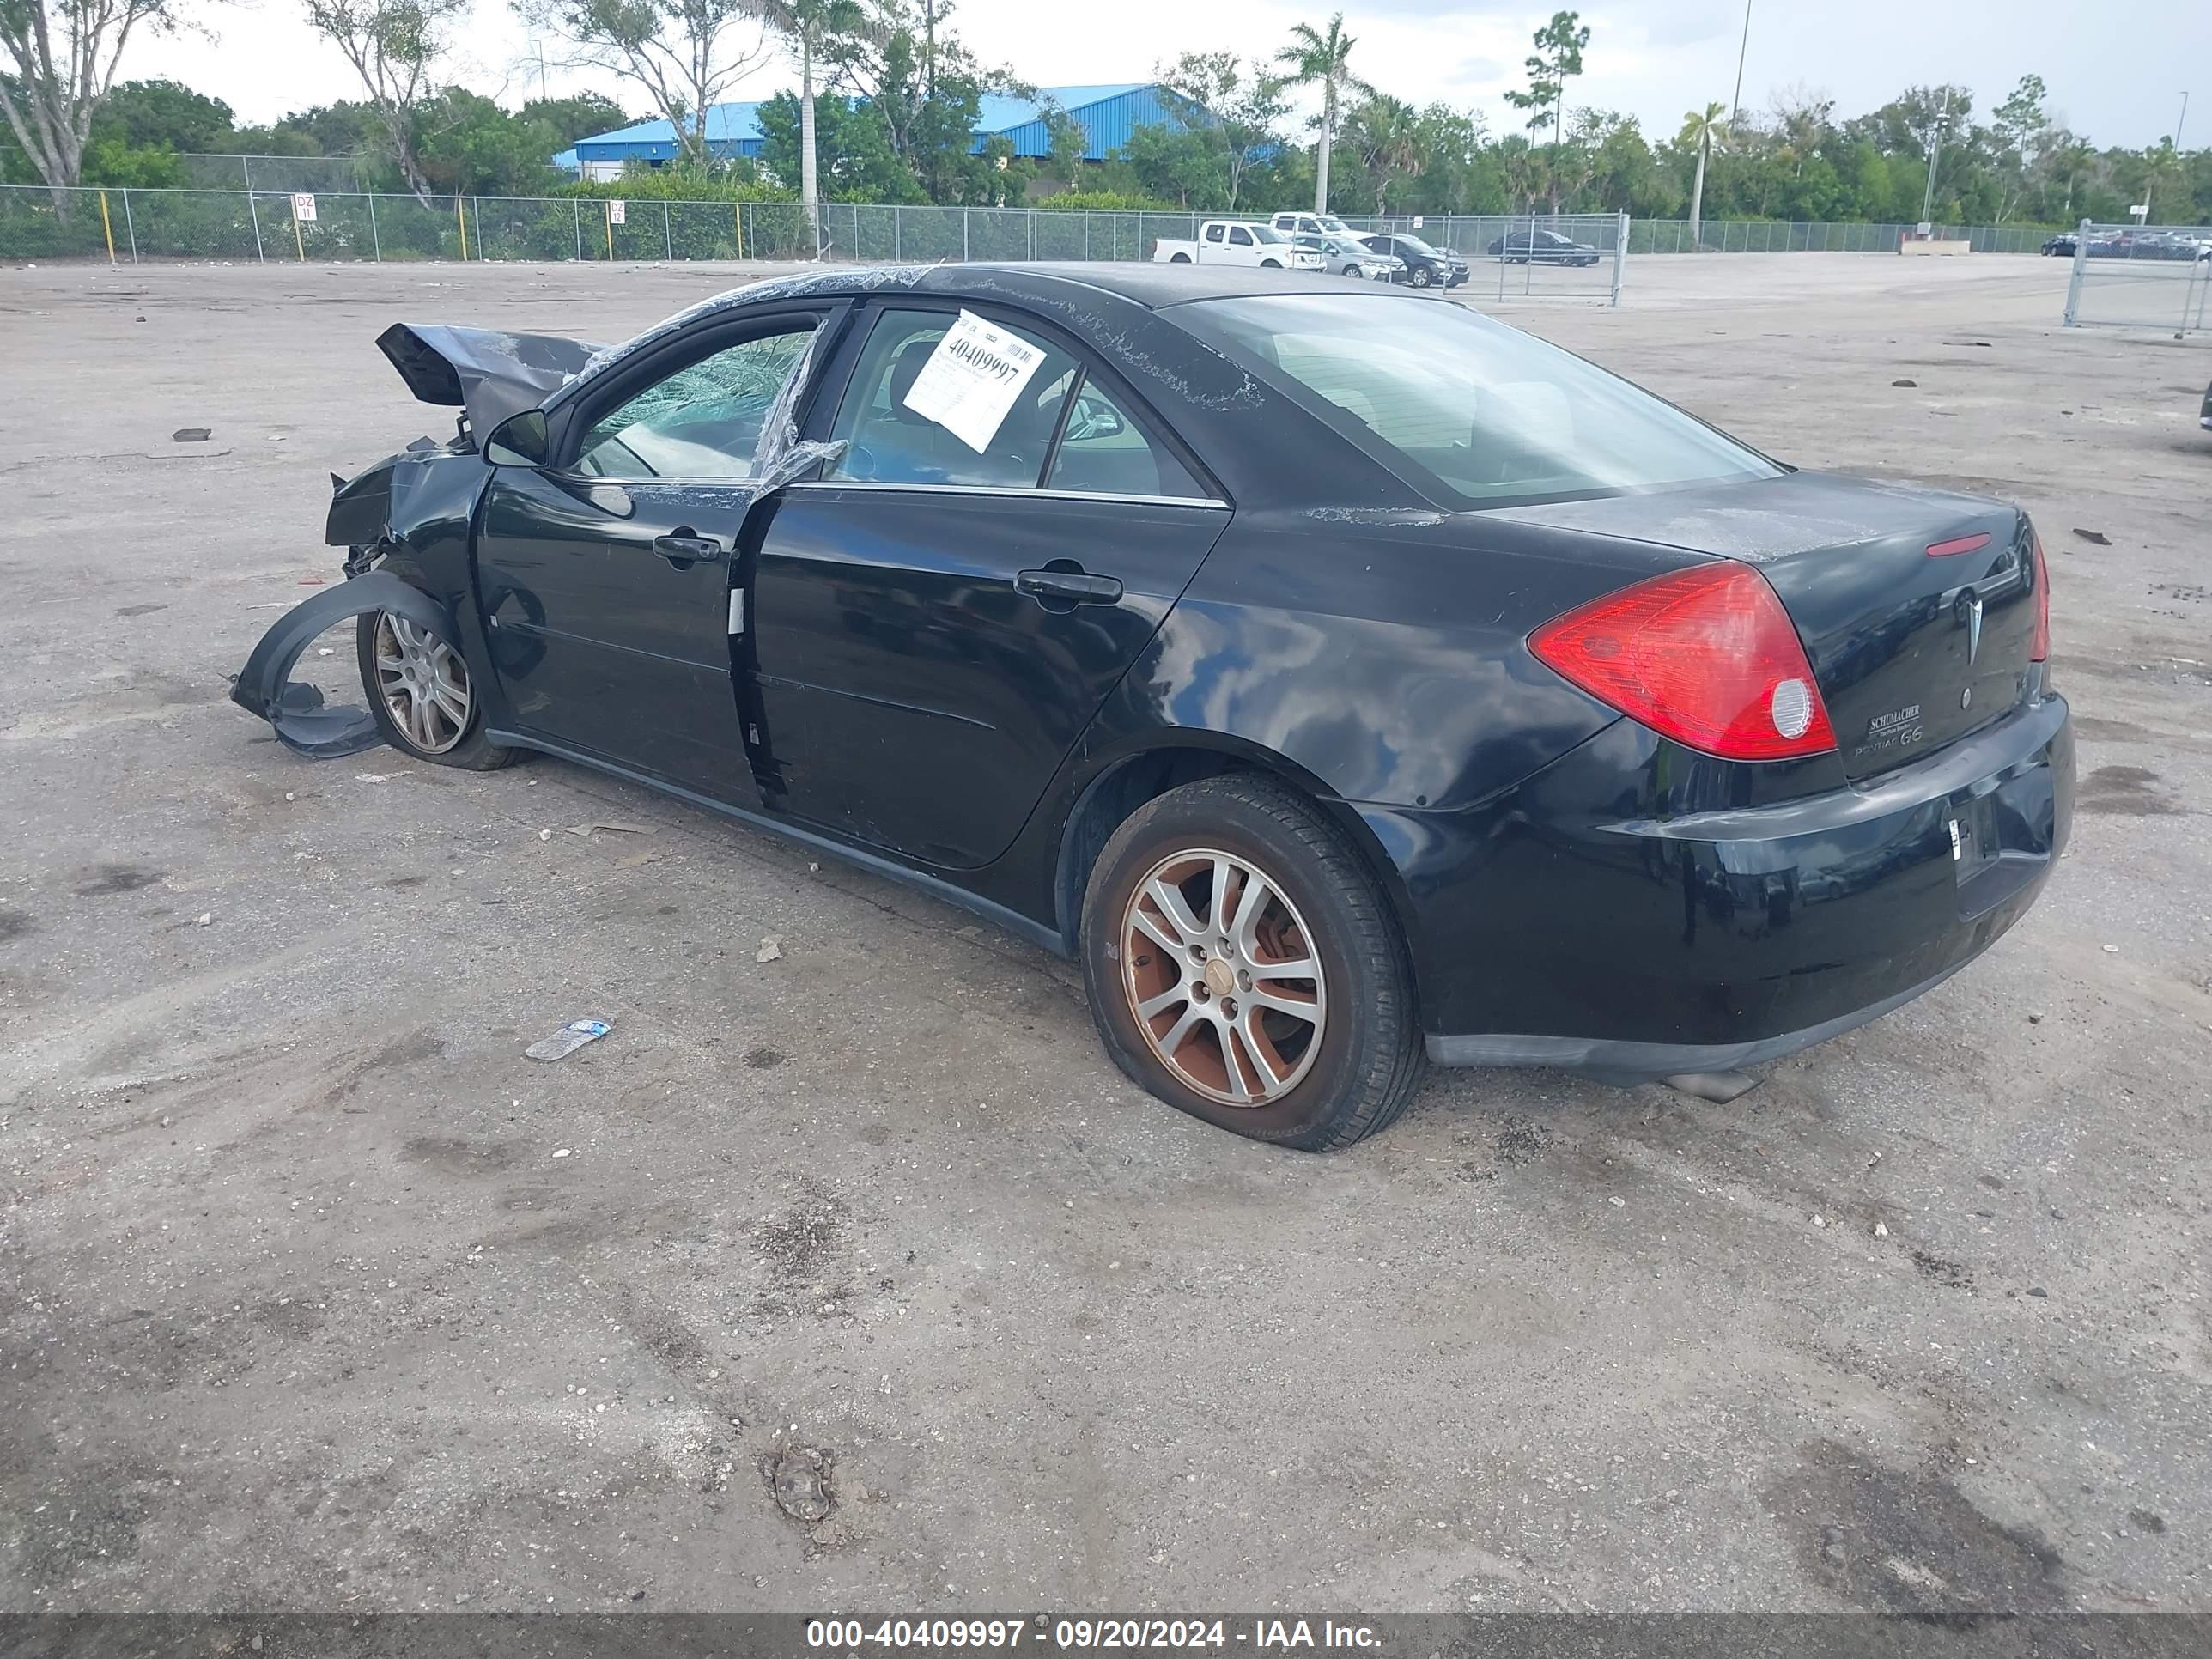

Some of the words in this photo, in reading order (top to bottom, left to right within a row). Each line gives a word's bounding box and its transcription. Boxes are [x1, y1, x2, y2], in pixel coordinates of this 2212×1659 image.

[297, 197, 313, 207] DZ
[611, 203, 623, 212] DZ
[302, 208, 311, 218] 11
[613, 213, 622, 222] 12
[949, 337, 1019, 386] 40409997
[1869, 704, 1920, 730] SCHUMACHER
[1900, 726, 1923, 745] G6
